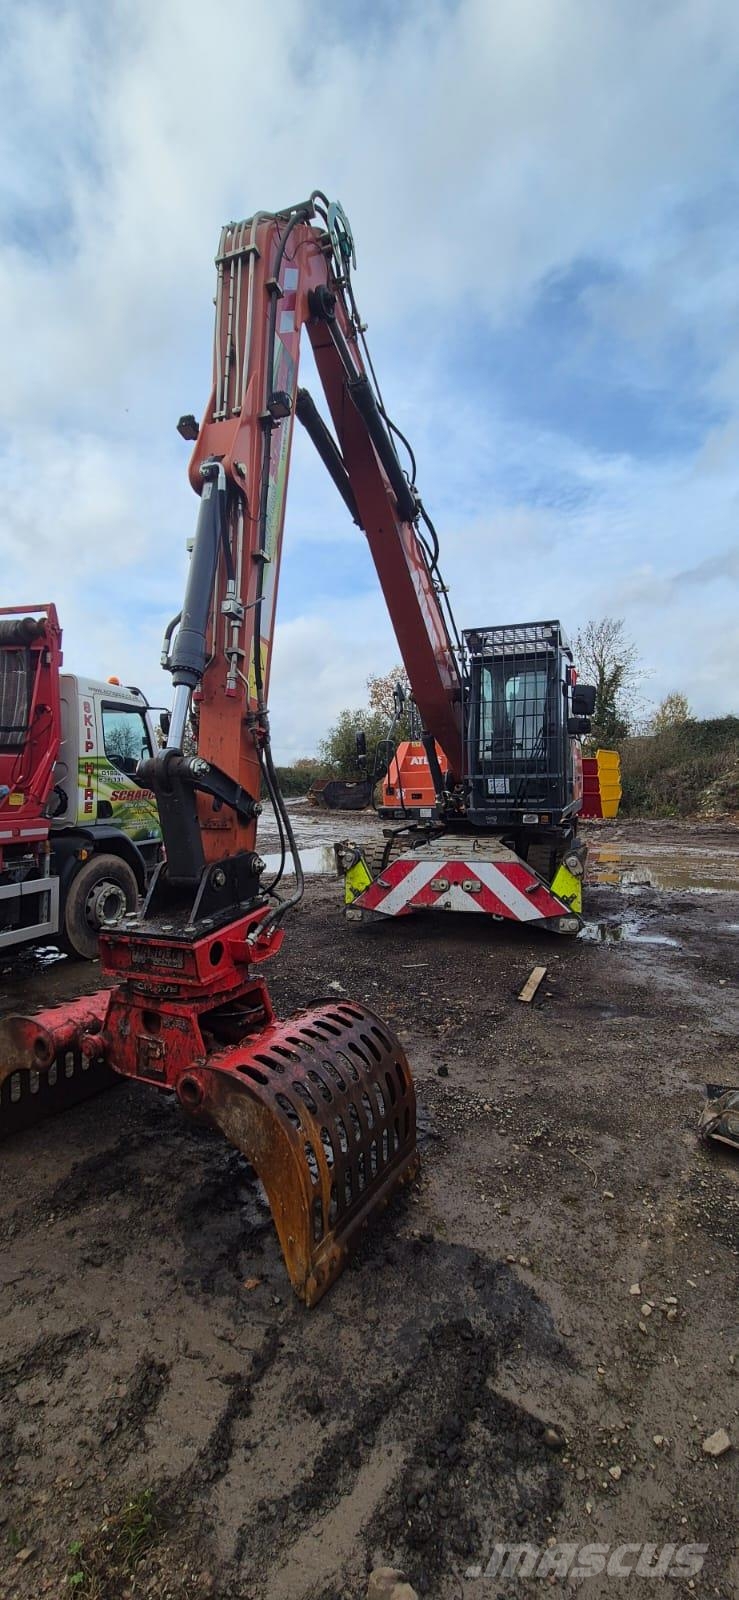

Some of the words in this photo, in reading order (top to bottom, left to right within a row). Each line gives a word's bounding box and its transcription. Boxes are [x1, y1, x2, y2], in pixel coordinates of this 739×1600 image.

[83, 701, 94, 753] SKIP
[410, 757, 443, 765] ATLS
[83, 761, 94, 814] HIRE
